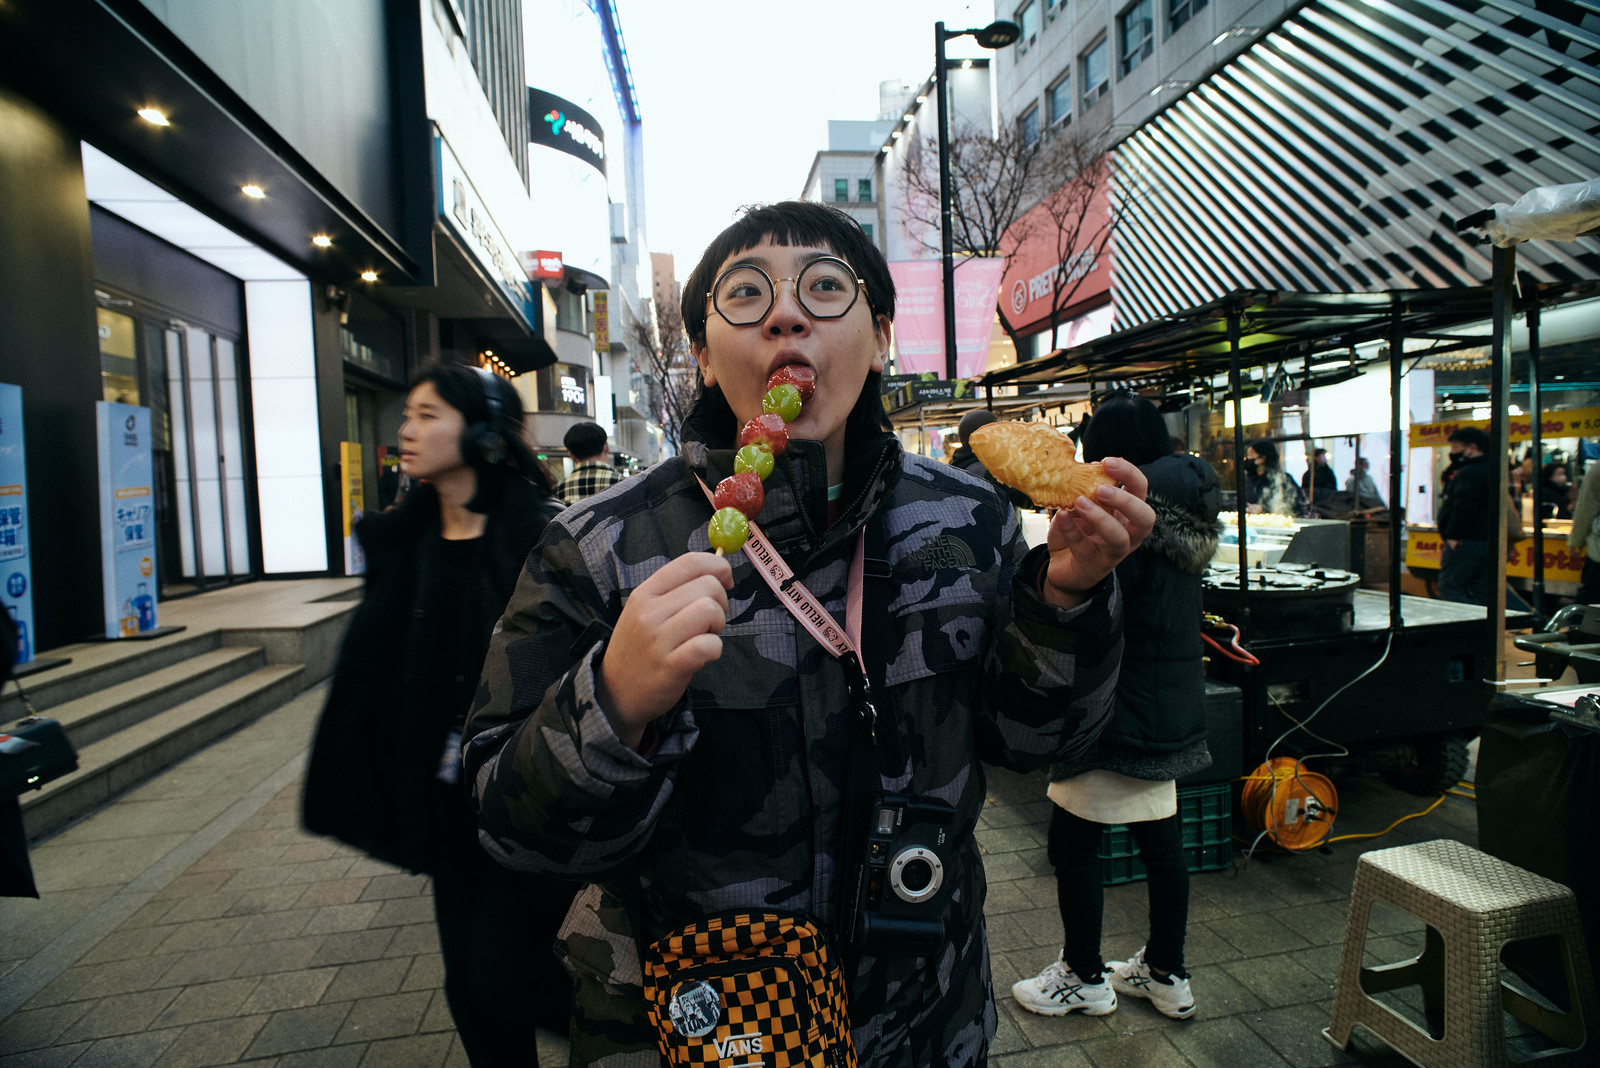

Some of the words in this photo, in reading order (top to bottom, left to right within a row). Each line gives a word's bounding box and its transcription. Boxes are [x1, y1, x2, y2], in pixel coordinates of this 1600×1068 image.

[595, 303, 608, 348] 부동산
[1510, 419, 1564, 436] Poto
[921, 534, 949, 548] THE
[751, 539, 774, 566] HELLO
[906, 545, 953, 562] NORTH
[923, 557, 955, 572] FACE
[800, 600, 826, 628] HELLO
[712, 1031, 763, 1059] VANS
